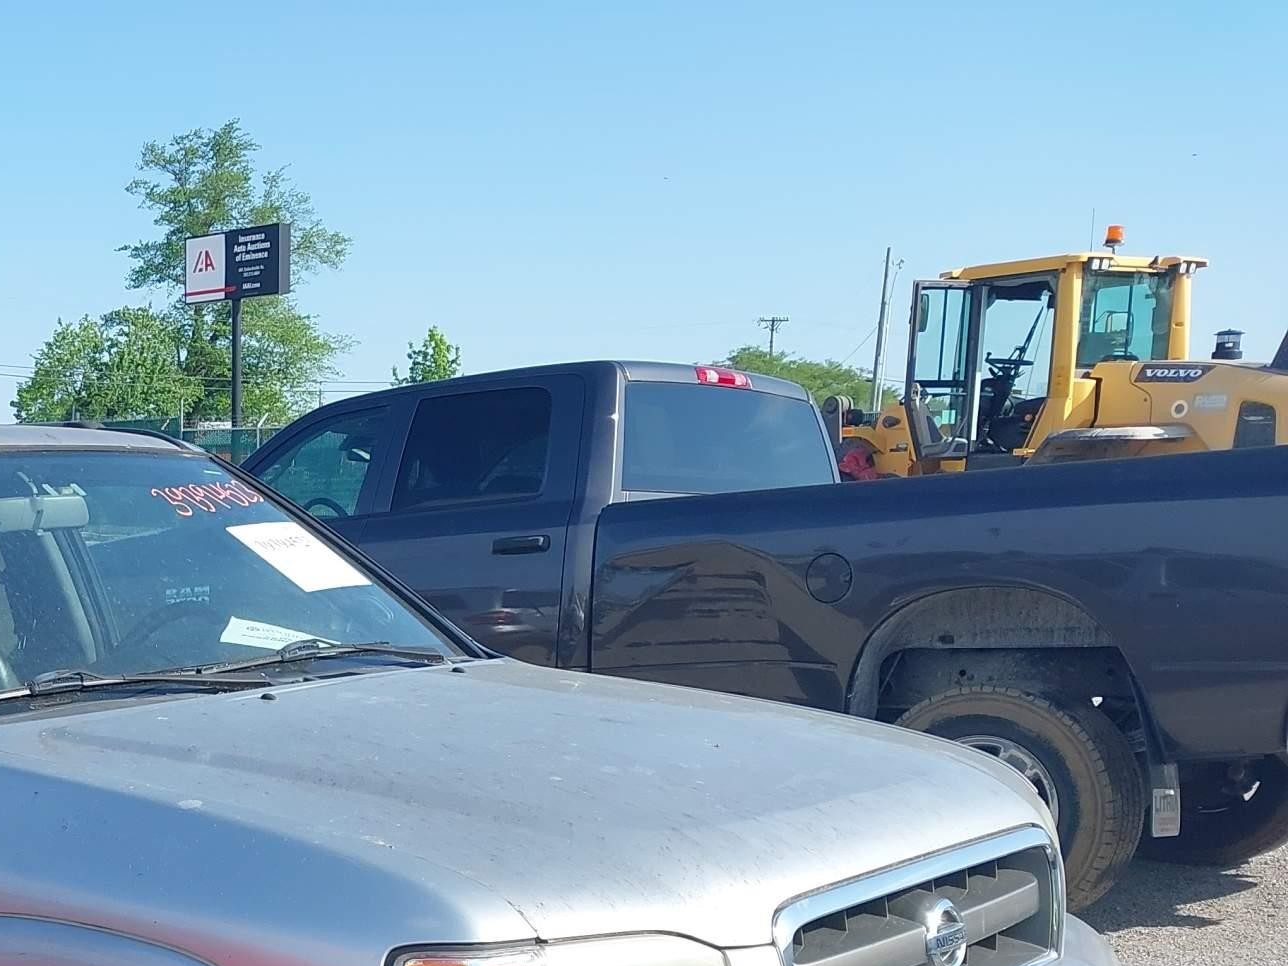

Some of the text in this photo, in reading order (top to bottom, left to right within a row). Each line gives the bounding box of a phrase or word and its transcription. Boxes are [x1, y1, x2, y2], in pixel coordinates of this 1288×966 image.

[238, 232, 265, 243] Insurance
[233, 241, 271, 253] Auto Auctions
[235, 251, 269, 262] of Eminence
[1144, 368, 1203, 378] VOLVO
